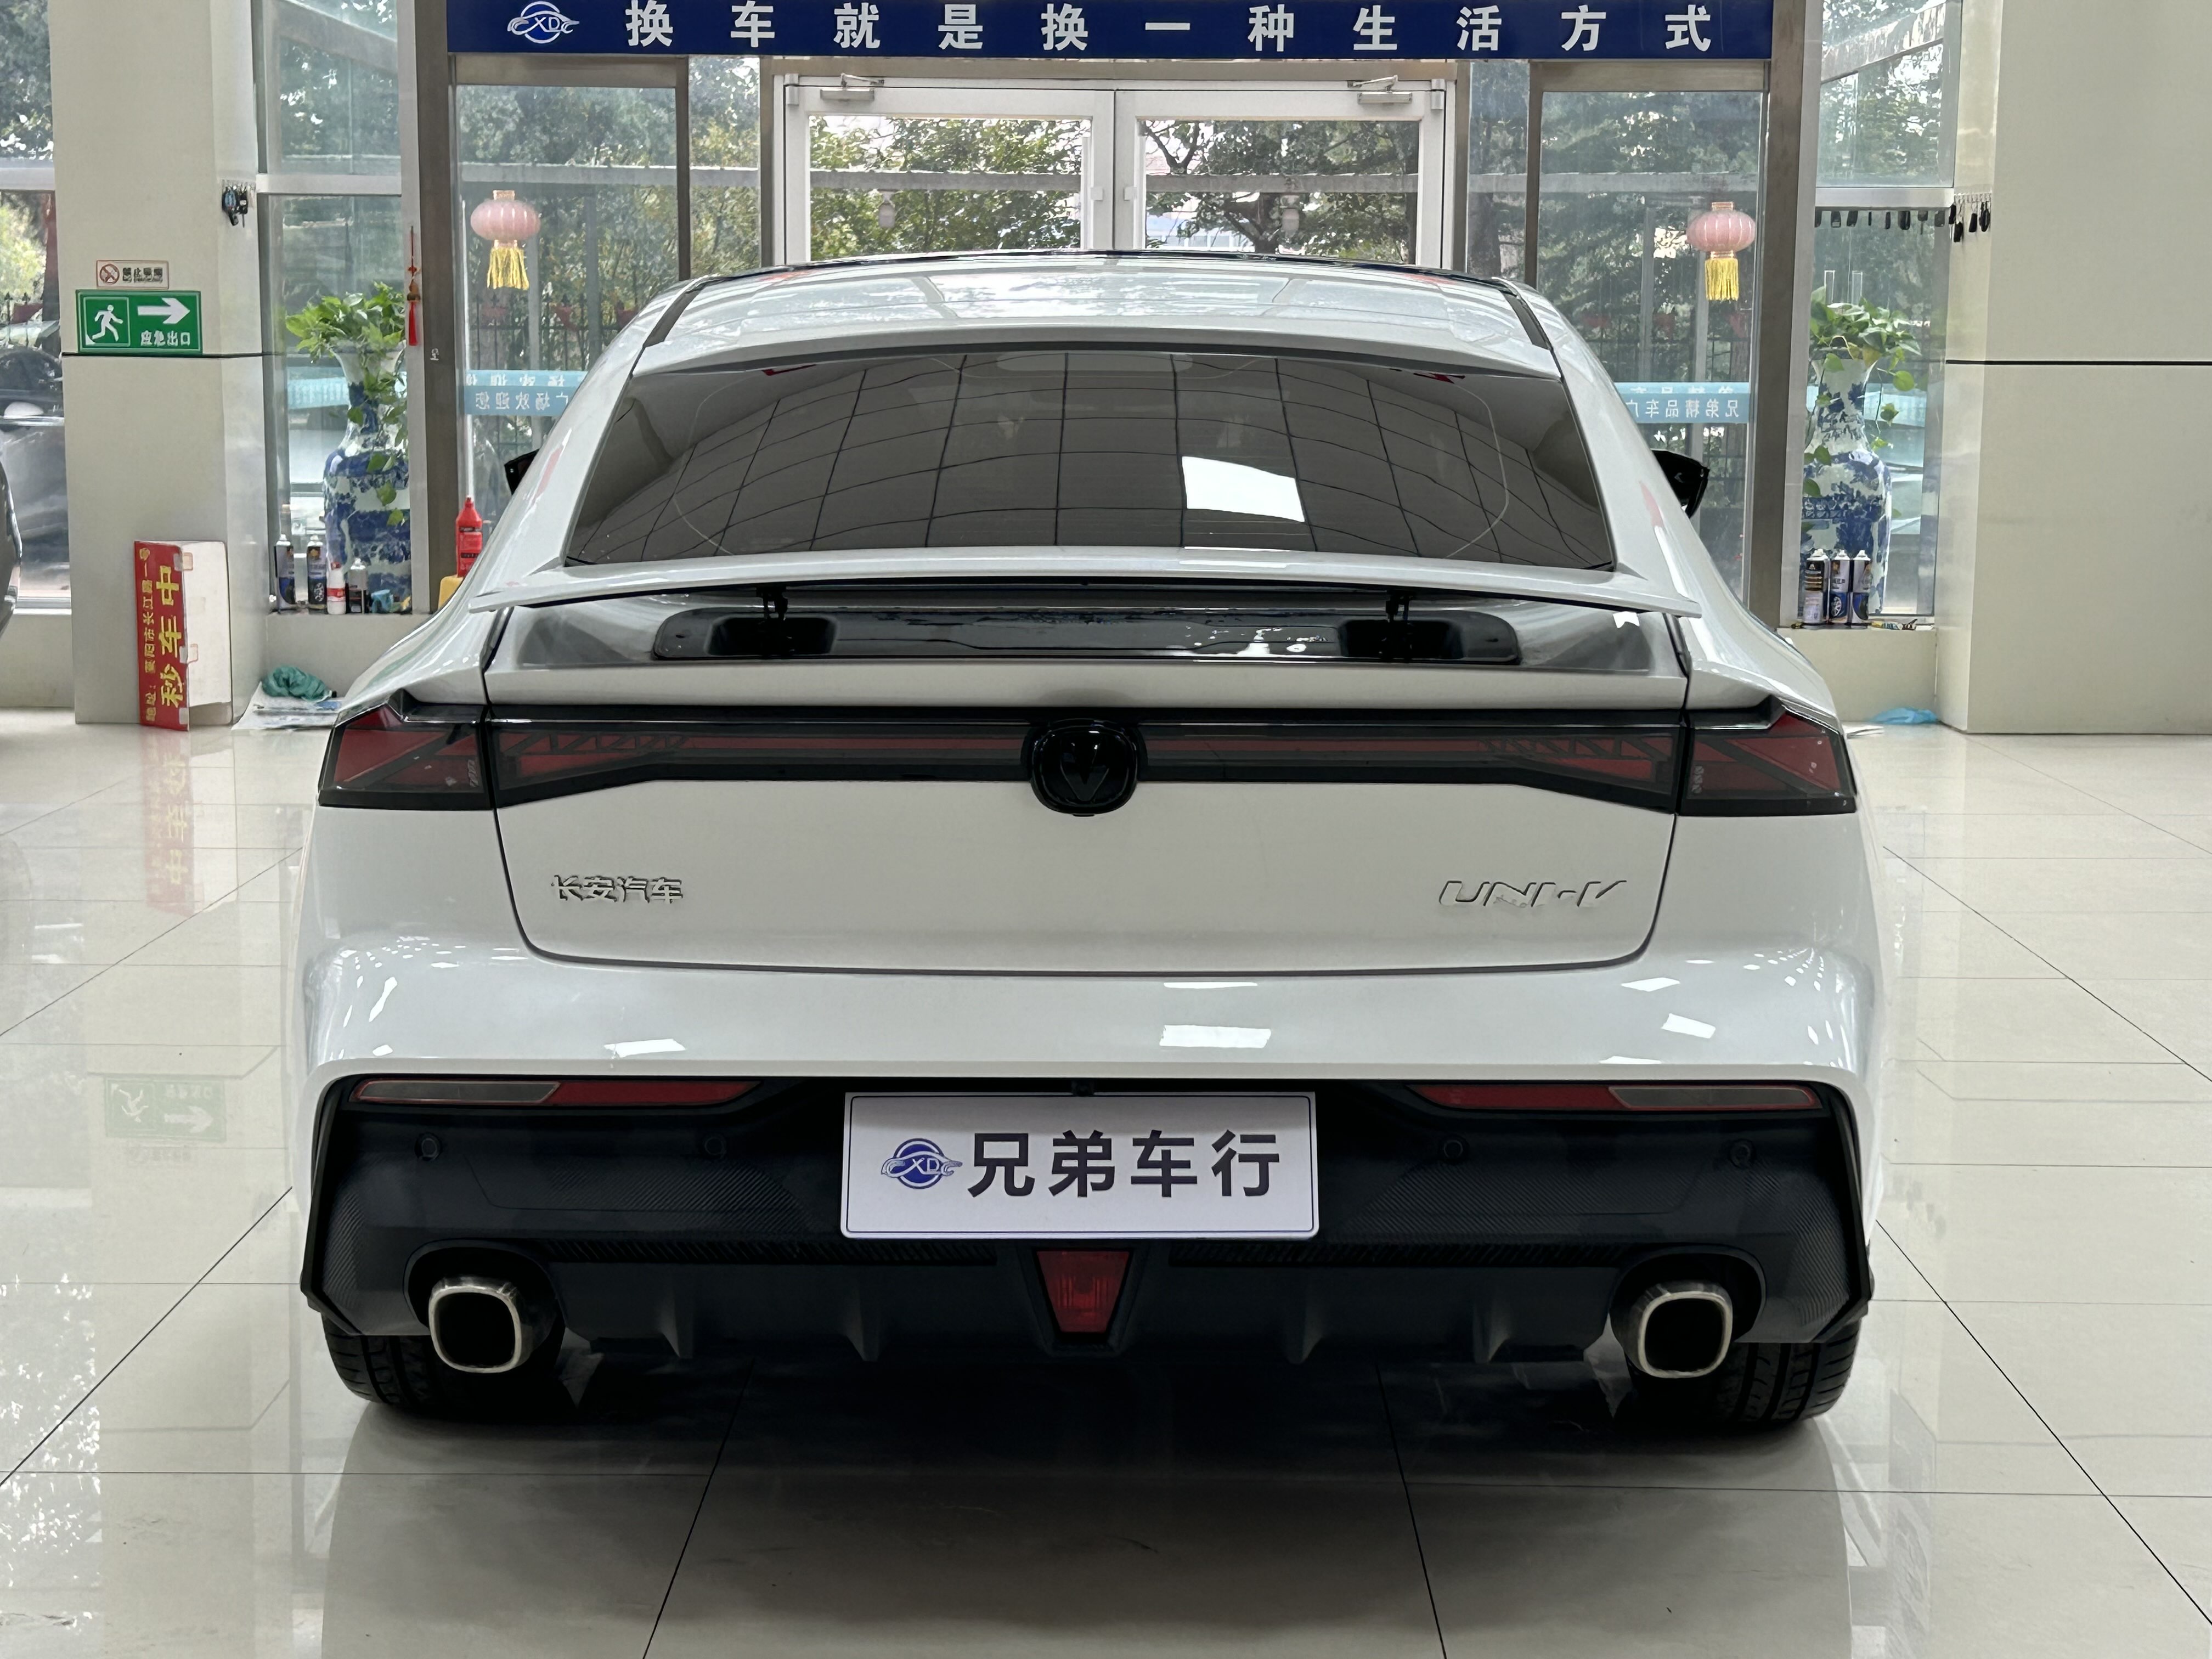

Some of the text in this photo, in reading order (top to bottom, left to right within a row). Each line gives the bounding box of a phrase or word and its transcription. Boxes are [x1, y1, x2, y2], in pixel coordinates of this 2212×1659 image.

[625, 0, 1711, 52] 换车就是换一种生活方式
[156, 566, 184, 708] 秒车中
[551, 874, 683, 904] 长安汽车
[968, 1129, 1280, 1198] 兄弟车行
